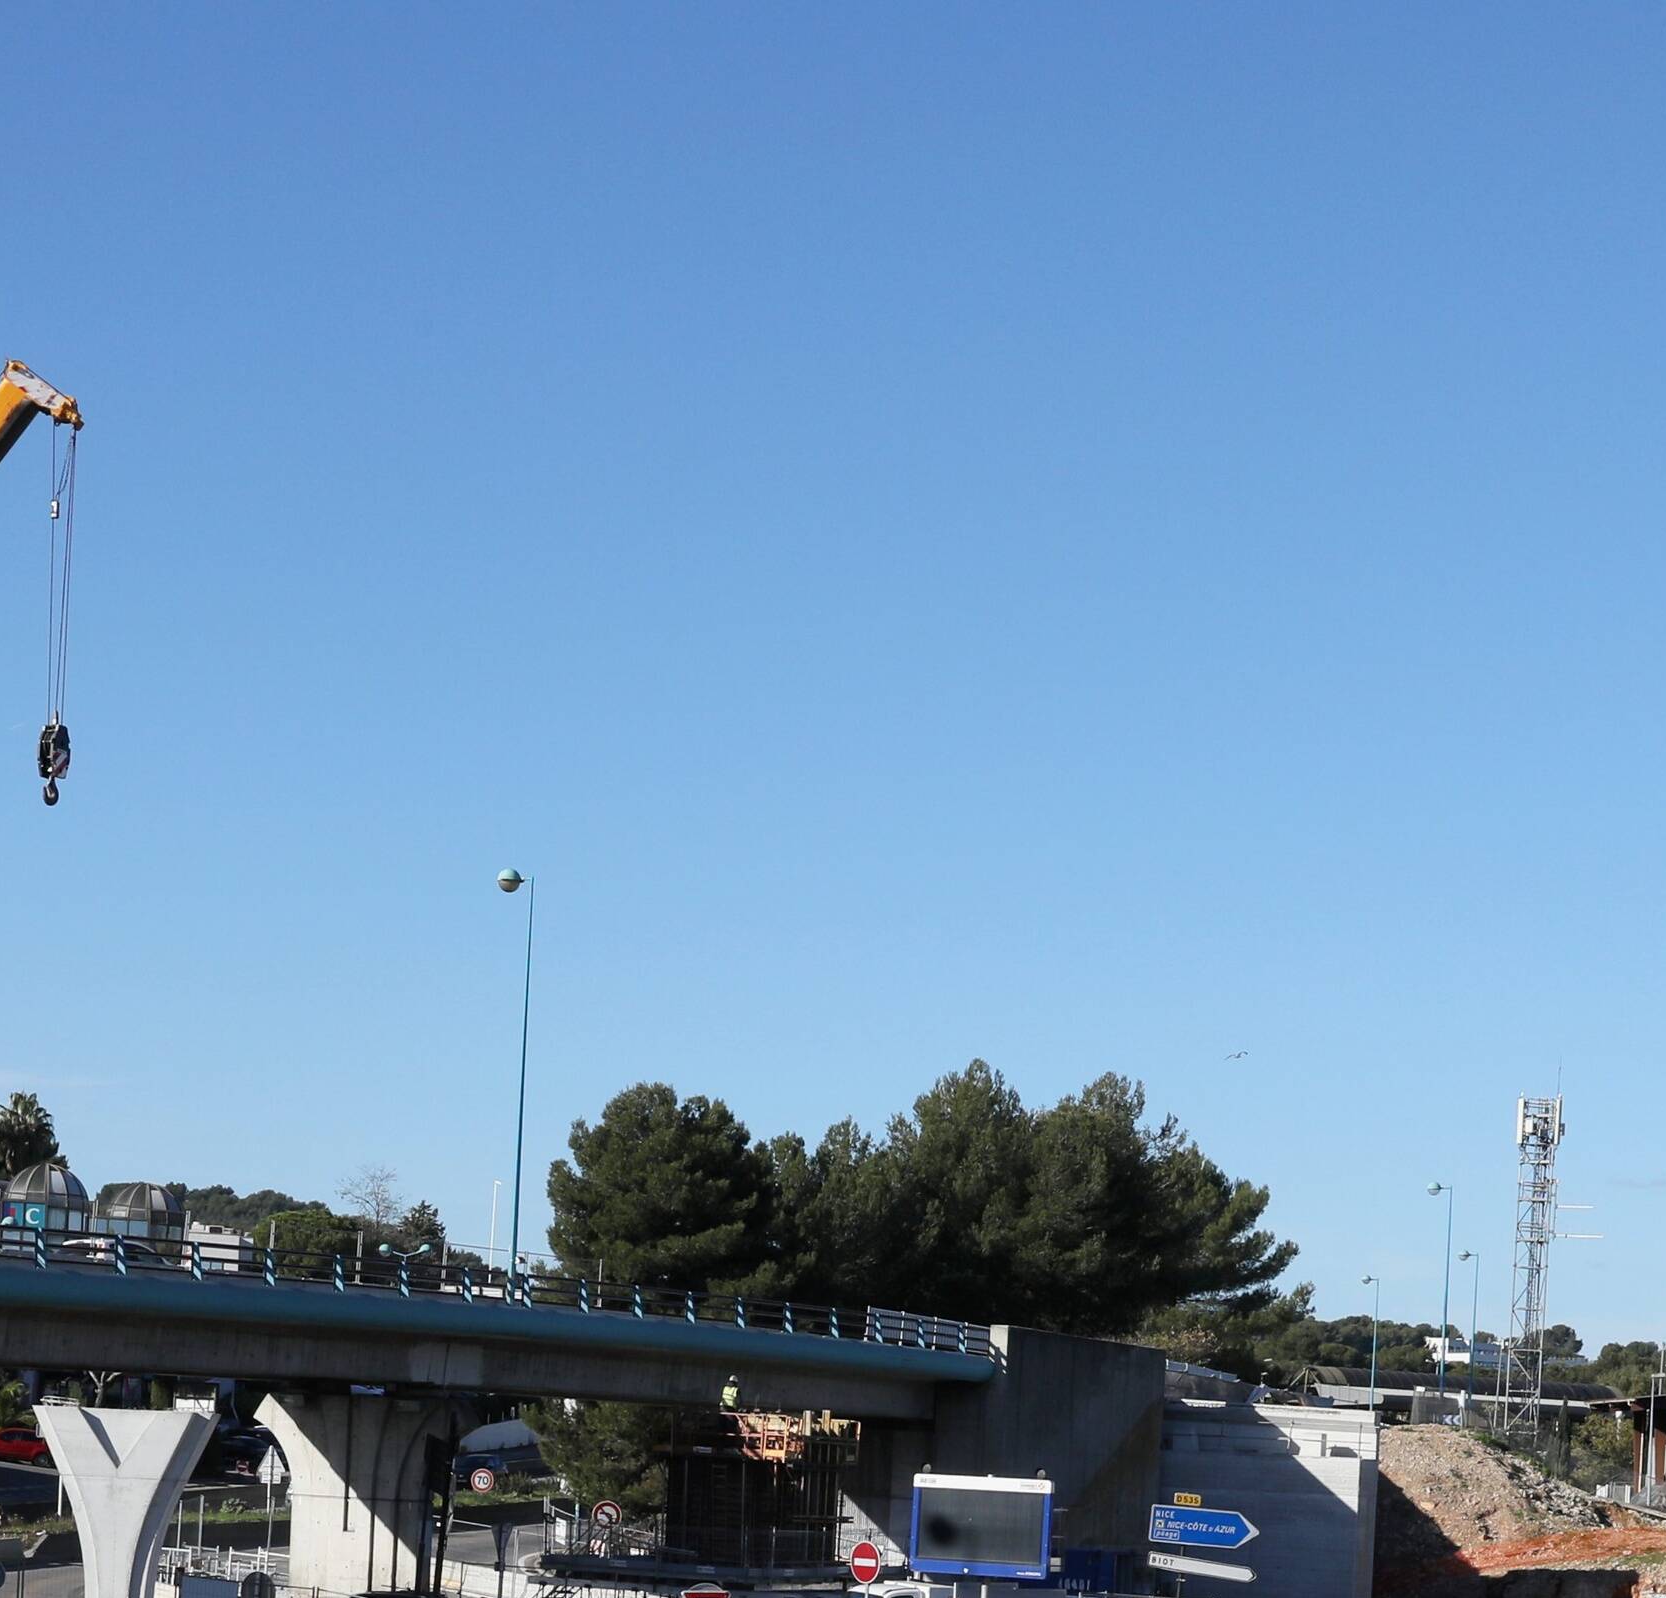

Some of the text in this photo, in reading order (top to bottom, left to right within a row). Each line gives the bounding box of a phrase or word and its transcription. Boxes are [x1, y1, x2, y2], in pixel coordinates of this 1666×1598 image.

[477, 1475, 489, 1485] 70
[1155, 1510, 1175, 1519] NICE
[1151, 1556, 1175, 1566] BIOT
